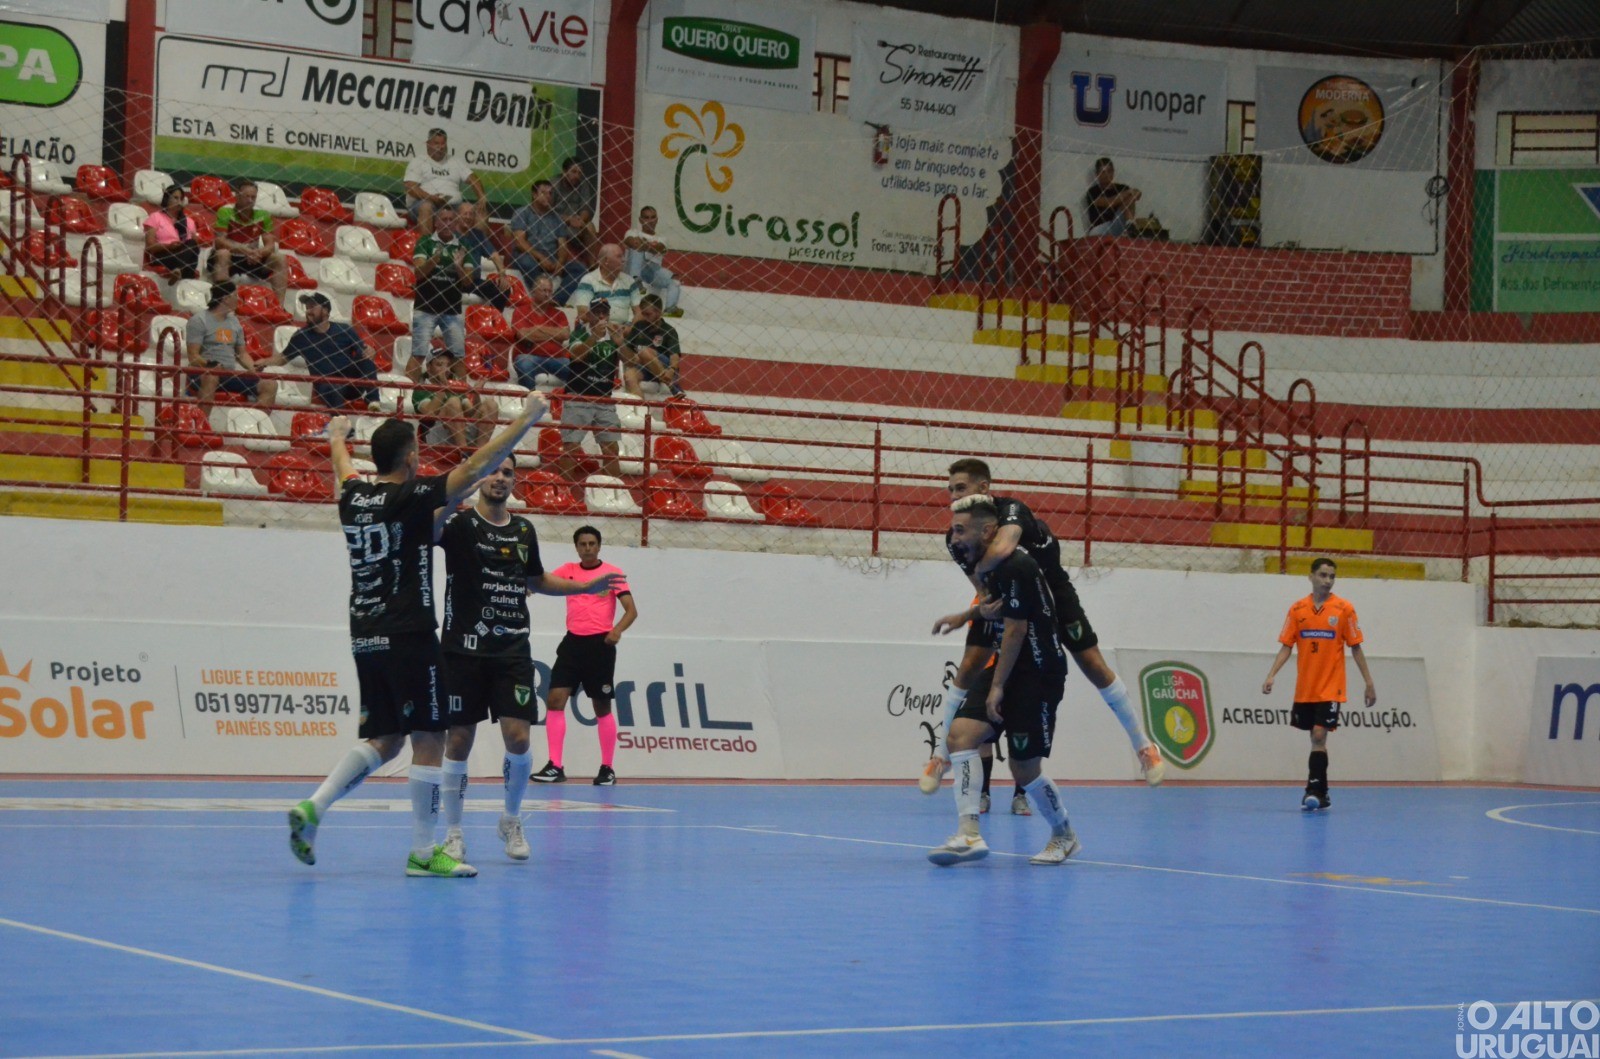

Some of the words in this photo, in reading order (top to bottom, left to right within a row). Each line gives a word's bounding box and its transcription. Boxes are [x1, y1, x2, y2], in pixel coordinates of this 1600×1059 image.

[670, 25, 729, 50] QUERO
[733, 35, 790, 60] QUERO
[918, 45, 967, 62] Restaurante
[877, 42, 984, 91] Simonetti
[1126, 88, 1206, 121] unopar
[1316, 89, 1370, 102] MODERNA
[172, 116, 216, 137] ESTA
[230, 124, 258, 143] SIM
[285, 130, 369, 154] CONFIAVEL
[376, 139, 416, 158] PARA
[464, 149, 519, 169] CARRO
[919, 139, 945, 153] mais
[948, 142, 999, 161] completa
[895, 159, 911, 169] em
[914, 159, 976, 178] brinquedos
[979, 168, 986, 179] e
[674, 143, 861, 249] Girassol
[881, 175, 931, 193] utilidades
[934, 181, 958, 197] para
[962, 186, 969, 196] o
[788, 246, 856, 262] presentes
[482, 582, 526, 595] mrjack.bet
[490, 595, 519, 605] sulnet
[356, 636, 390, 647] Stella
[463, 633, 478, 650] 10
[50, 661, 141, 686] Projeto
[201, 669, 243, 685] LIGUE
[246, 670, 254, 685] E
[257, 671, 338, 687] ECONOMIZE
[1162, 675, 1185, 687] LIGA
[195, 692, 230, 713] 051
[234, 693, 351, 715] 99774-3574
[887, 684, 942, 717] Chopp
[1152, 686, 1199, 700] GAÚCHA
[0, 686, 154, 740] Solar
[216, 717, 272, 736] PAINÉIS
[274, 721, 337, 737] SOLARES
[616, 731, 757, 753] Supermercado
